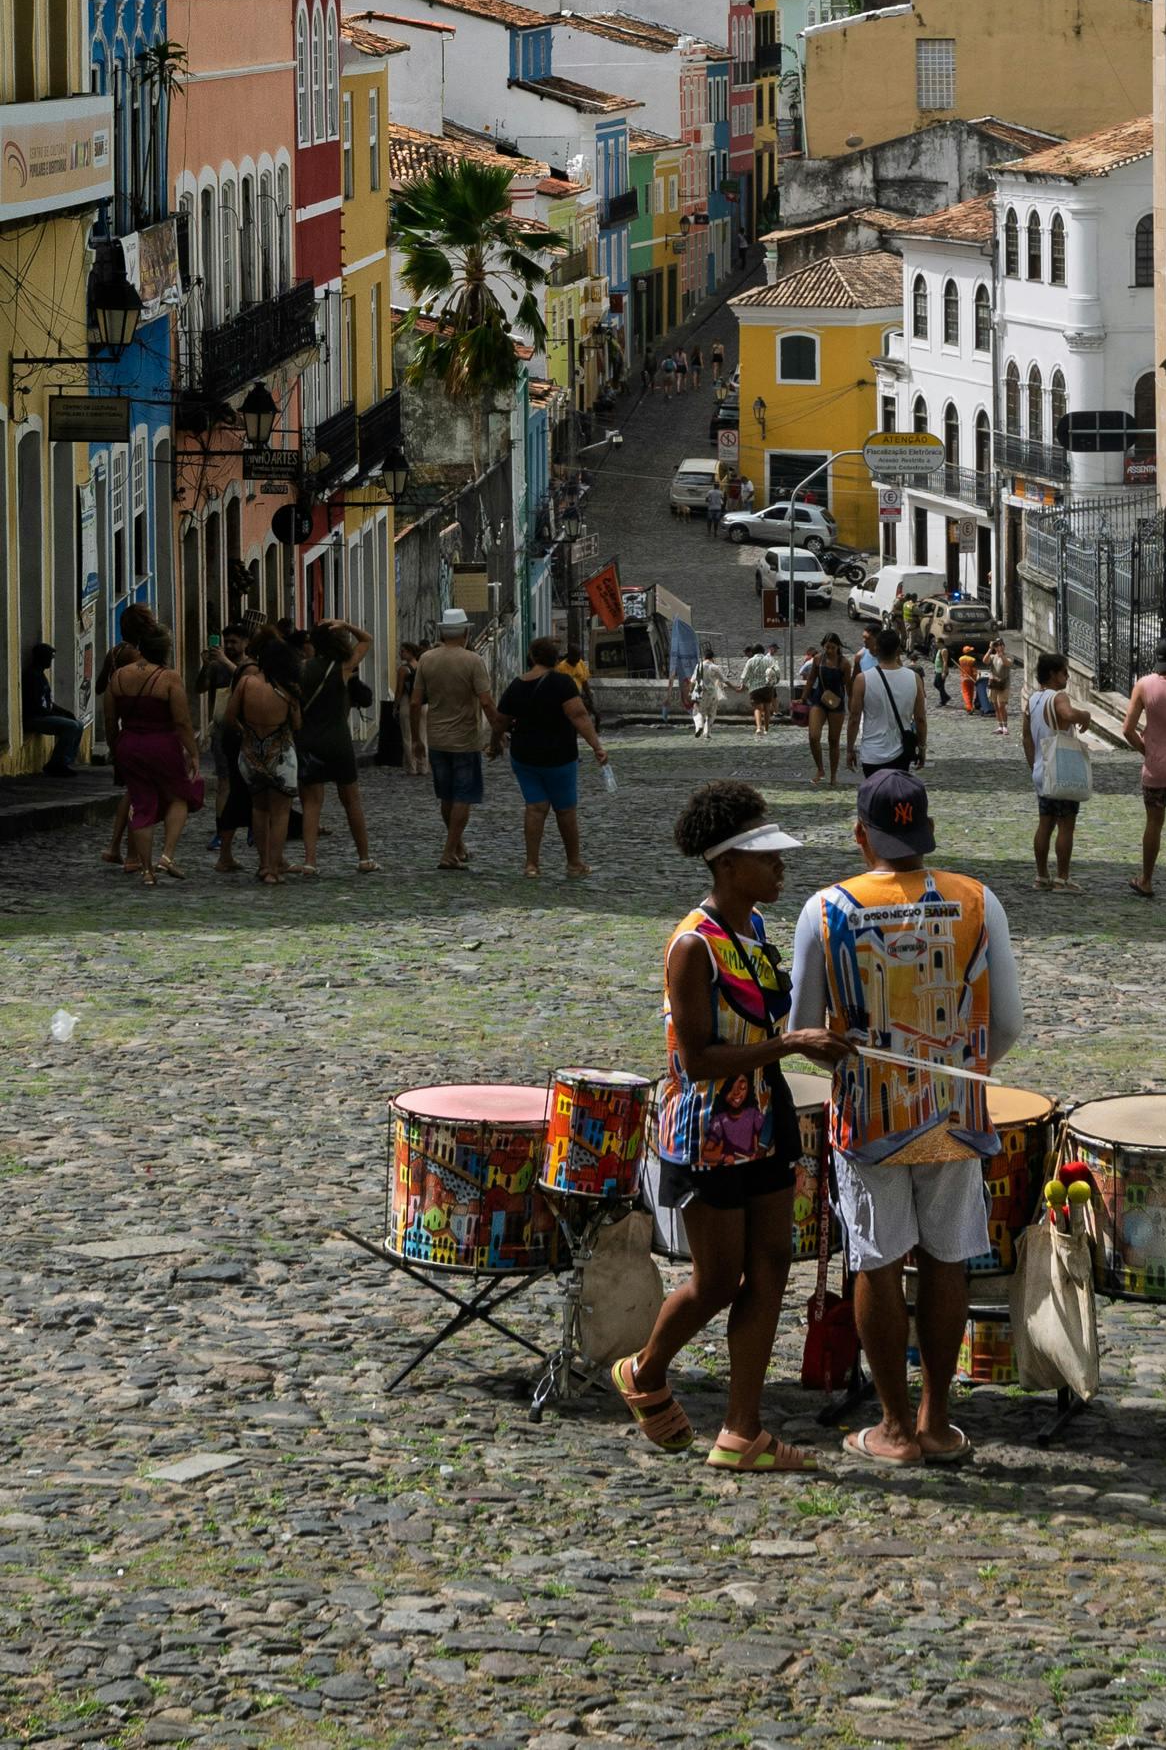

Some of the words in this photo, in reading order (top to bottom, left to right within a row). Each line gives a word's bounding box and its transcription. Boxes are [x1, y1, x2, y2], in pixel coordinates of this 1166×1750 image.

[883, 435, 928, 444] ATENÇÃO
[866, 448, 907, 456] Fiscalização
[909, 448, 942, 456] Eletrônica
[271, 451, 298, 466] ARTES
[889, 908, 922, 920] NEGRO
[924, 906, 961, 919] BAHIA
